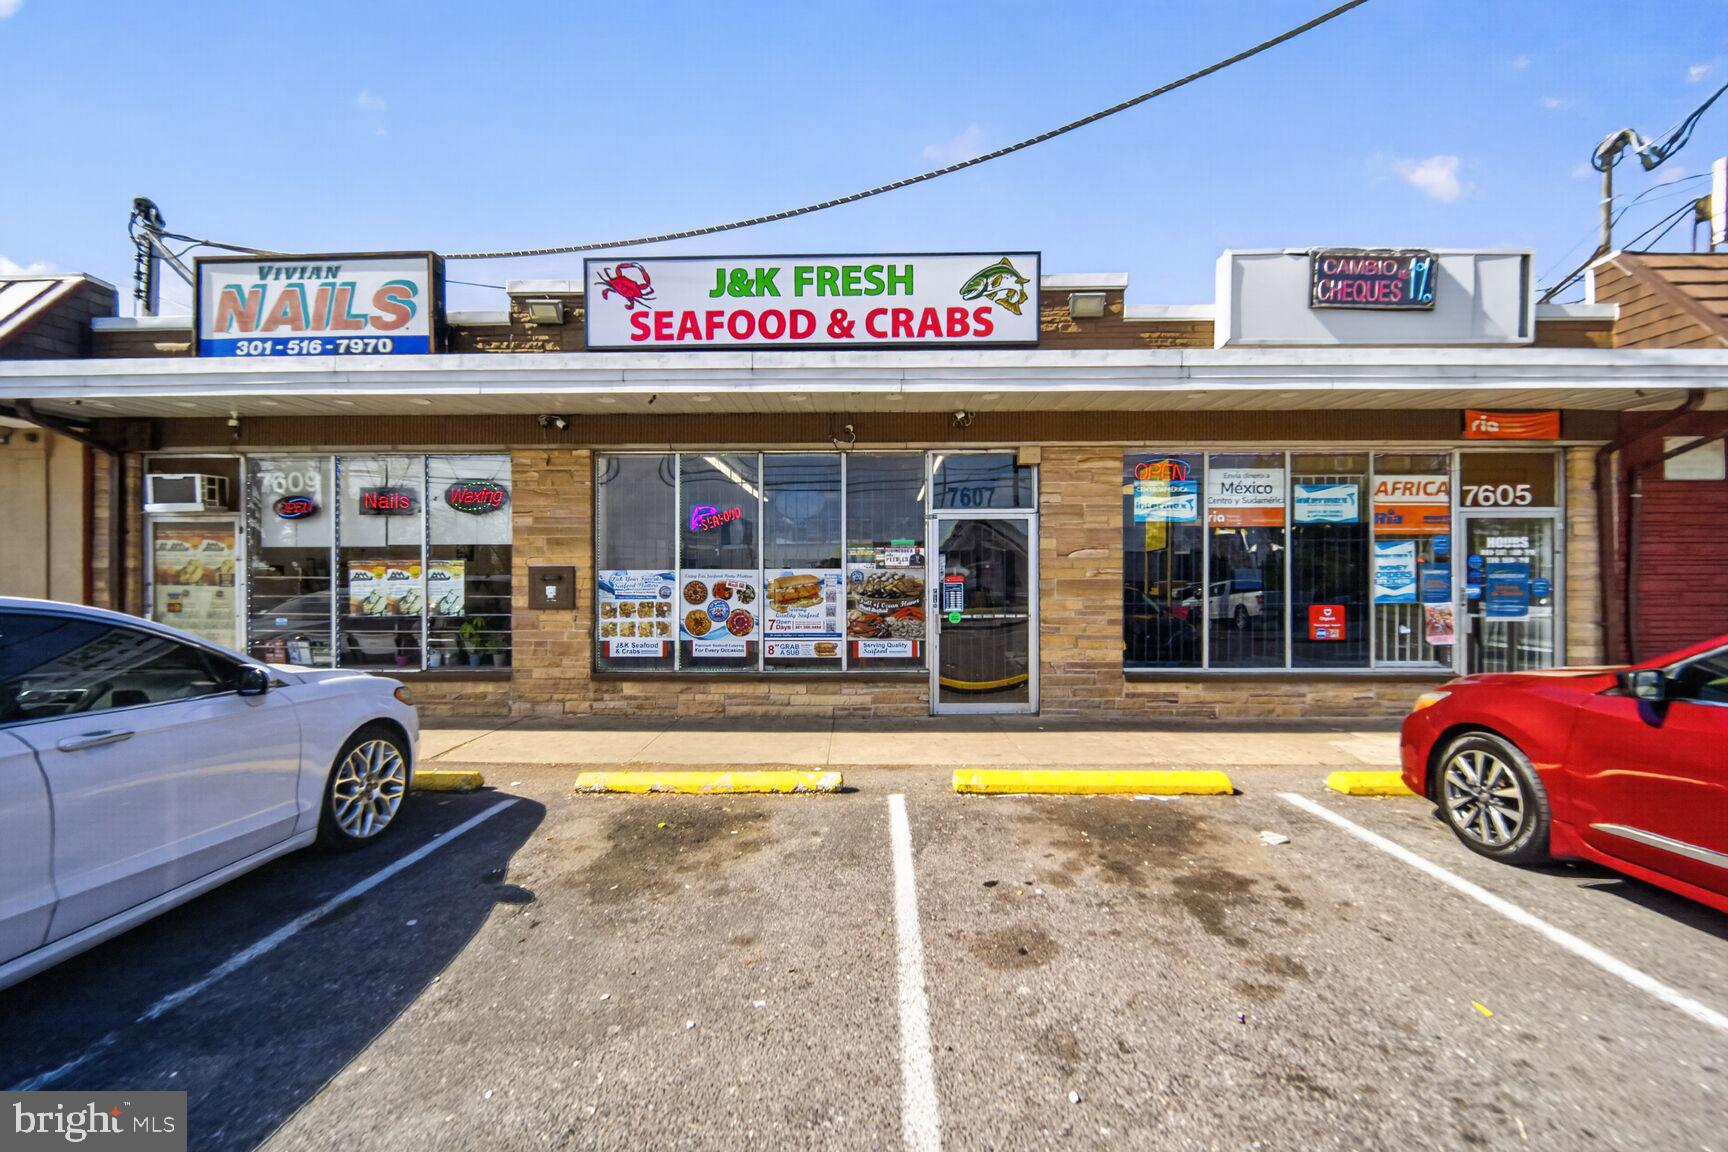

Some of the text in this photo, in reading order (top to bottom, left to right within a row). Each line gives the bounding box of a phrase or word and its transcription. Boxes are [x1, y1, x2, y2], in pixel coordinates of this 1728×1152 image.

[258, 265, 342, 281] VIVIAN
[1324, 258, 1398, 276] CAMBIO
[709, 264, 915, 298] J&K FRESH
[1317, 279, 1403, 302] CHEQUES
[213, 279, 419, 333] NAILS
[630, 306, 994, 342] SEAFOOD & CRABS
[1134, 461, 1187, 481] OPEN
[257, 471, 321, 495] 7609
[1220, 480, 1273, 495] México
[1374, 480, 1449, 497] AFRICA
[364, 490, 412, 509] Nails
[450, 487, 503, 507] Waxing
[948, 486, 995, 507] 7607
[1207, 496, 1233, 504] Centro
[1233, 498, 1240, 506] y
[1462, 484, 1533, 506] 7605
[768, 618, 776, 631] 7
[775, 624, 792, 632] Days
[631, 641, 659, 649] Seafood
